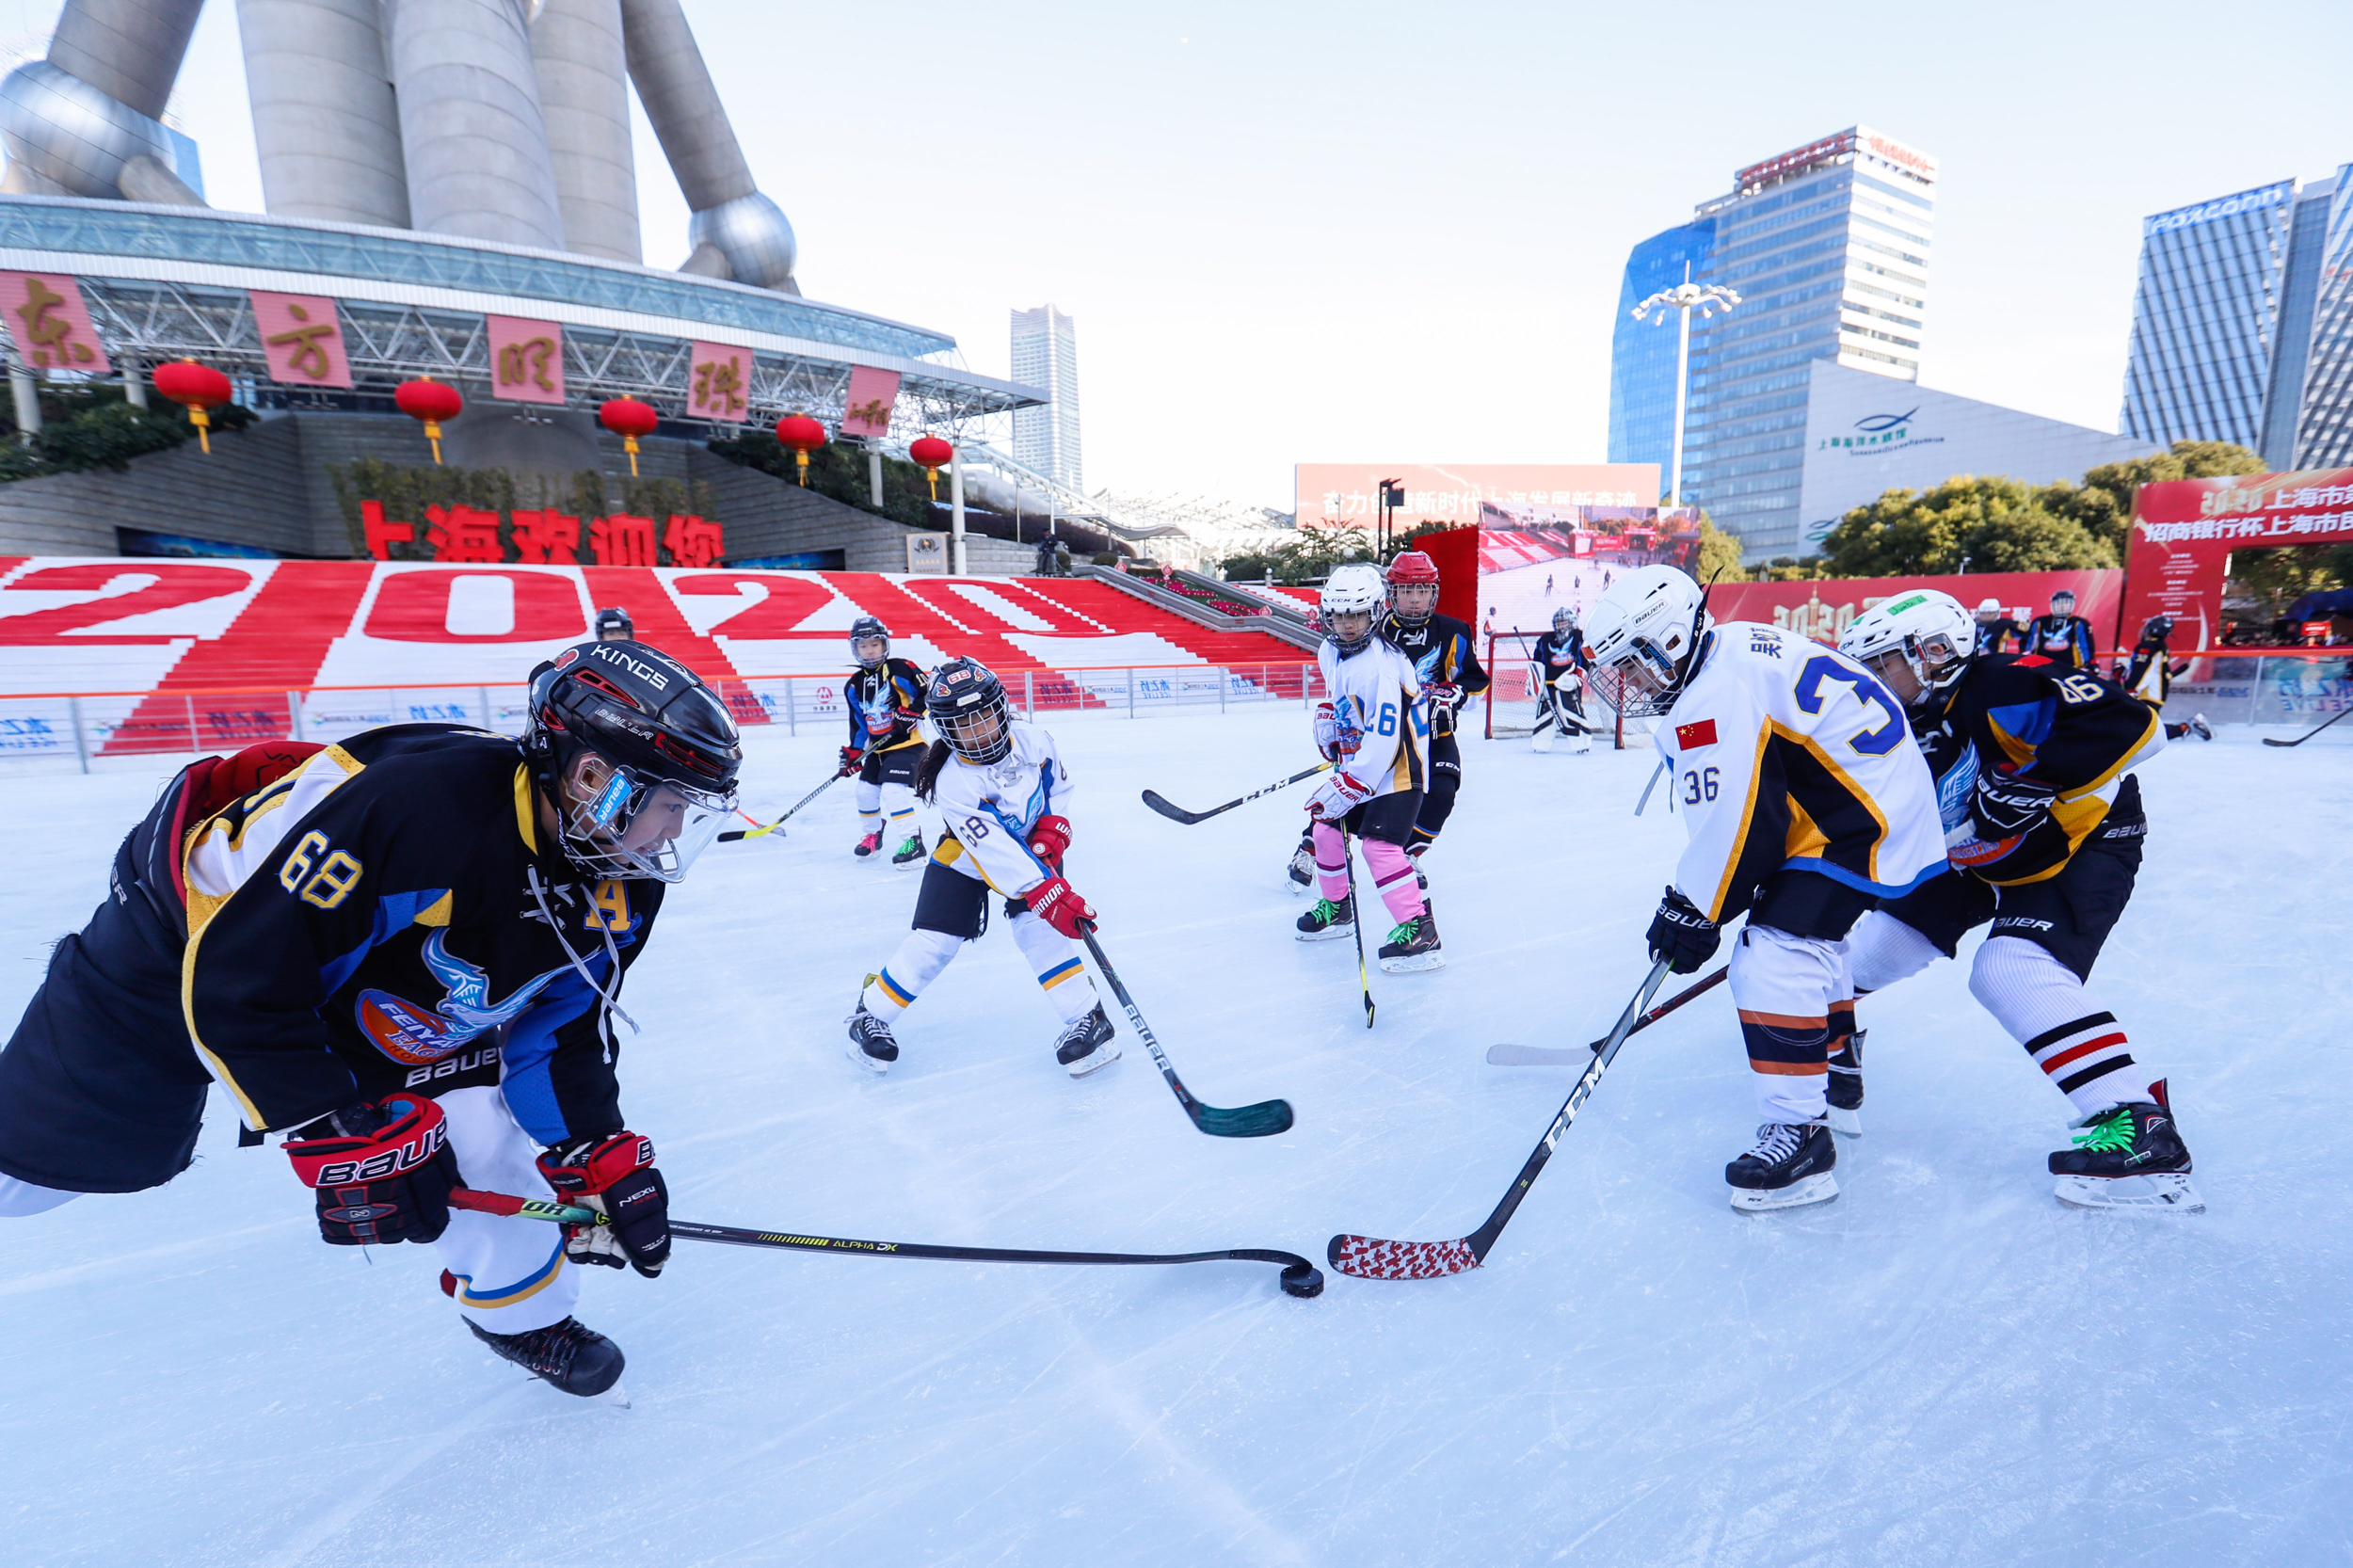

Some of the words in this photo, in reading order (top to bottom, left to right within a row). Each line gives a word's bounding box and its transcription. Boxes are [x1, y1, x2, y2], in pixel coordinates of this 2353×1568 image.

[1634, 601, 1665, 625] BAUER
[590, 644, 669, 692] KINGS
[948, 671, 970, 683] 68
[1941, 664, 1958, 675] CCM
[598, 776, 627, 824] BAUER
[1241, 777, 1290, 804] CCM
[1330, 776, 1359, 802] BAUER
[1684, 766, 1721, 805] 36
[960, 816, 989, 848] 68
[280, 829, 364, 910] 68
[584, 879, 636, 934] A
[1124, 1003, 1172, 1073] BAUER
[1543, 1055, 1606, 1152] CCM
[833, 1240, 874, 1251] ALPHA
[876, 1242, 898, 1252] DX
